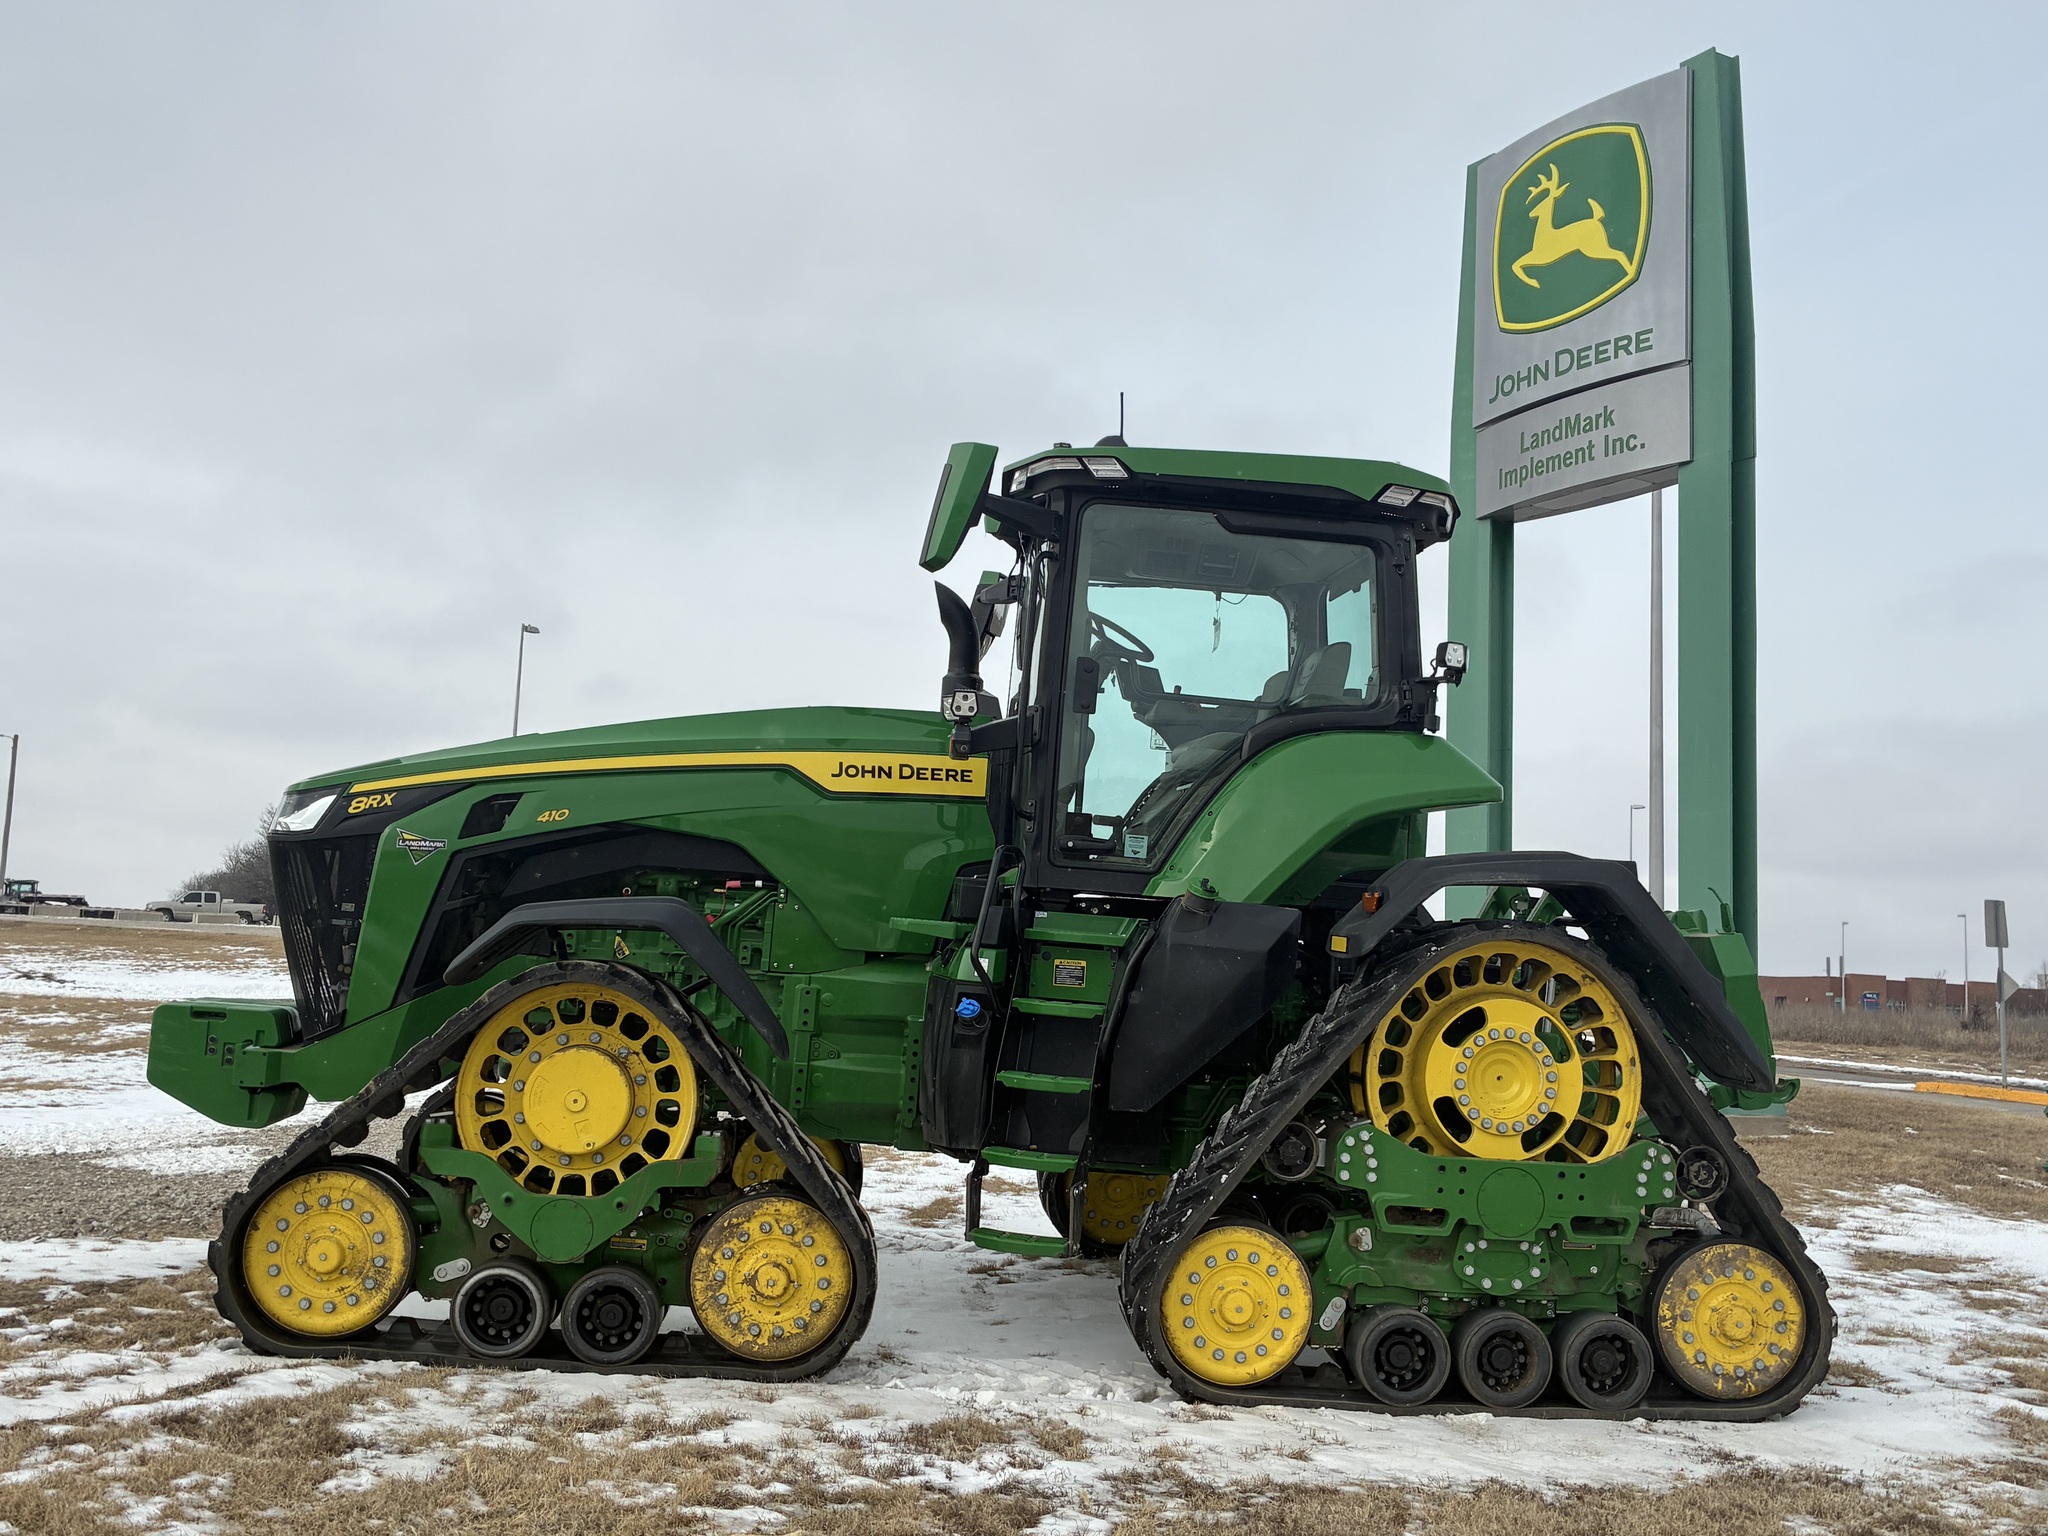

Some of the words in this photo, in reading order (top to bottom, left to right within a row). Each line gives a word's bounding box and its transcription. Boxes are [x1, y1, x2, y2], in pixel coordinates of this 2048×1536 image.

[1489, 360, 1549, 404] JOHN
[1555, 328, 1653, 377] DEERE
[1520, 405, 1616, 454] LandMark
[1499, 440, 1595, 490] Implement
[1604, 433, 1645, 458] Inc.
[831, 762, 892, 779] JOHN
[898, 763, 973, 783] DEERE
[347, 792, 397, 814] 8RX
[536, 809, 570, 822] 410
